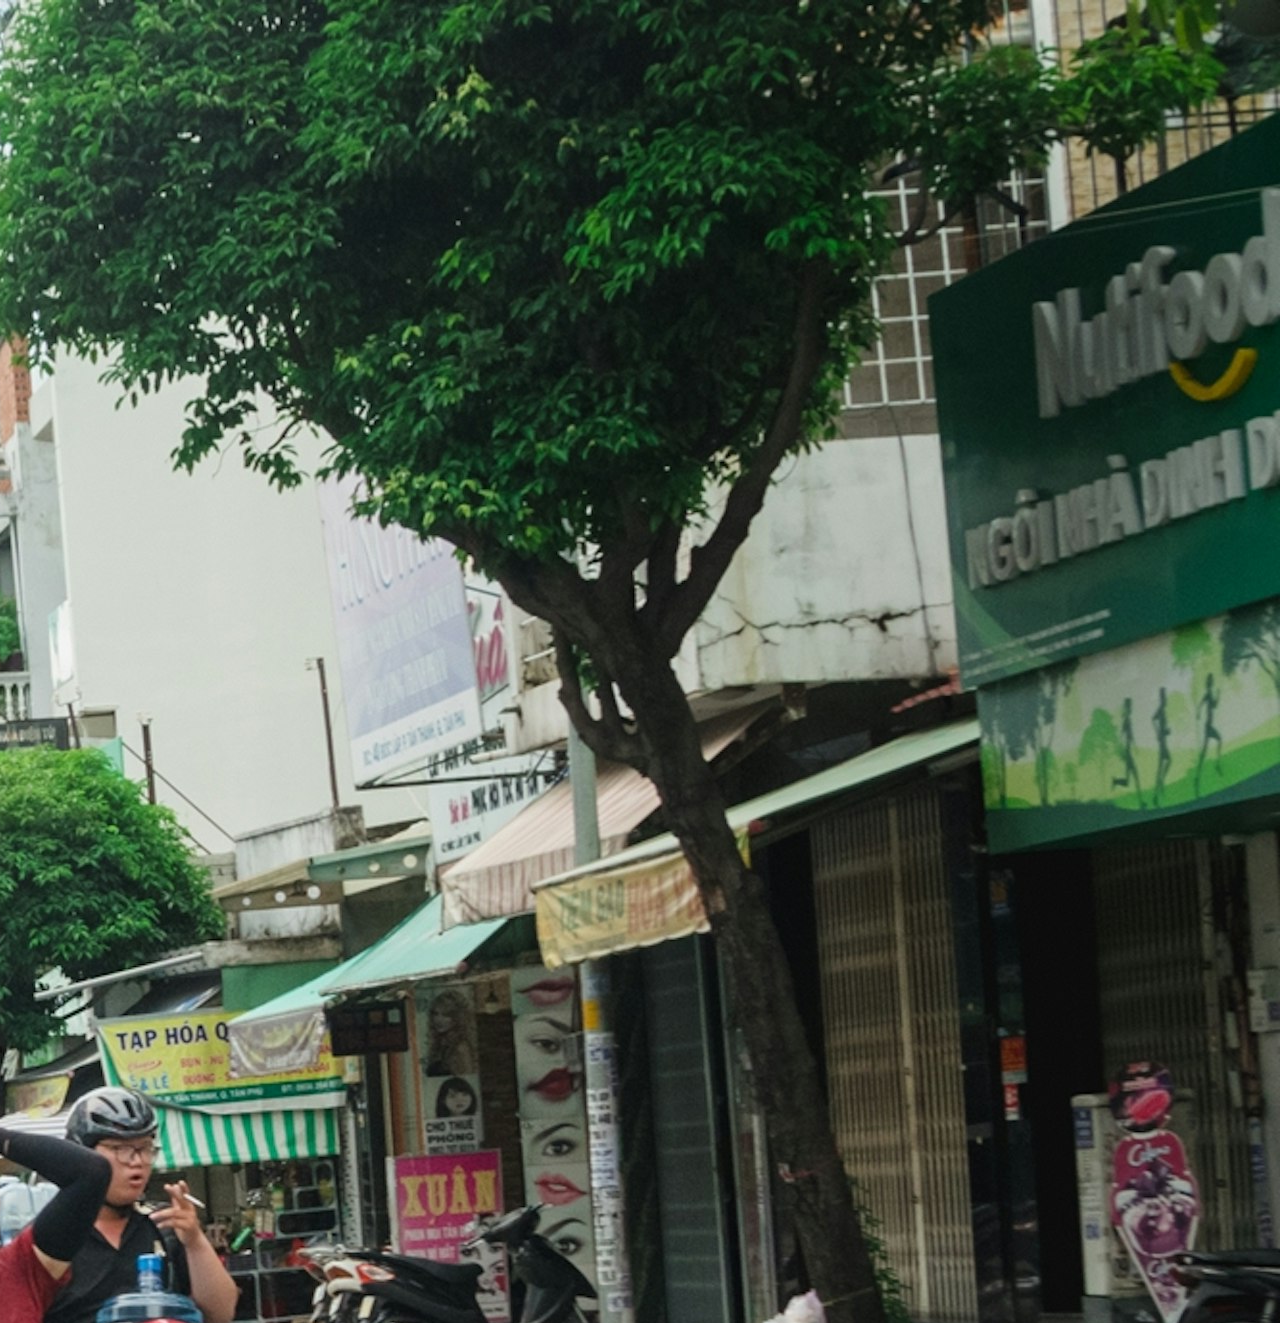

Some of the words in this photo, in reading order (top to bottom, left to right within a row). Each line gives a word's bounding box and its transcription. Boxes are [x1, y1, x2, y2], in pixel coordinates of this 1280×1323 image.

[1141, 428, 1247, 530] DINH
[116, 1029, 158, 1054] TẠP
[165, 1021, 207, 1046] HÓA
[215, 1021, 230, 1043] Q
[400, 1165, 496, 1217] XUÂN
